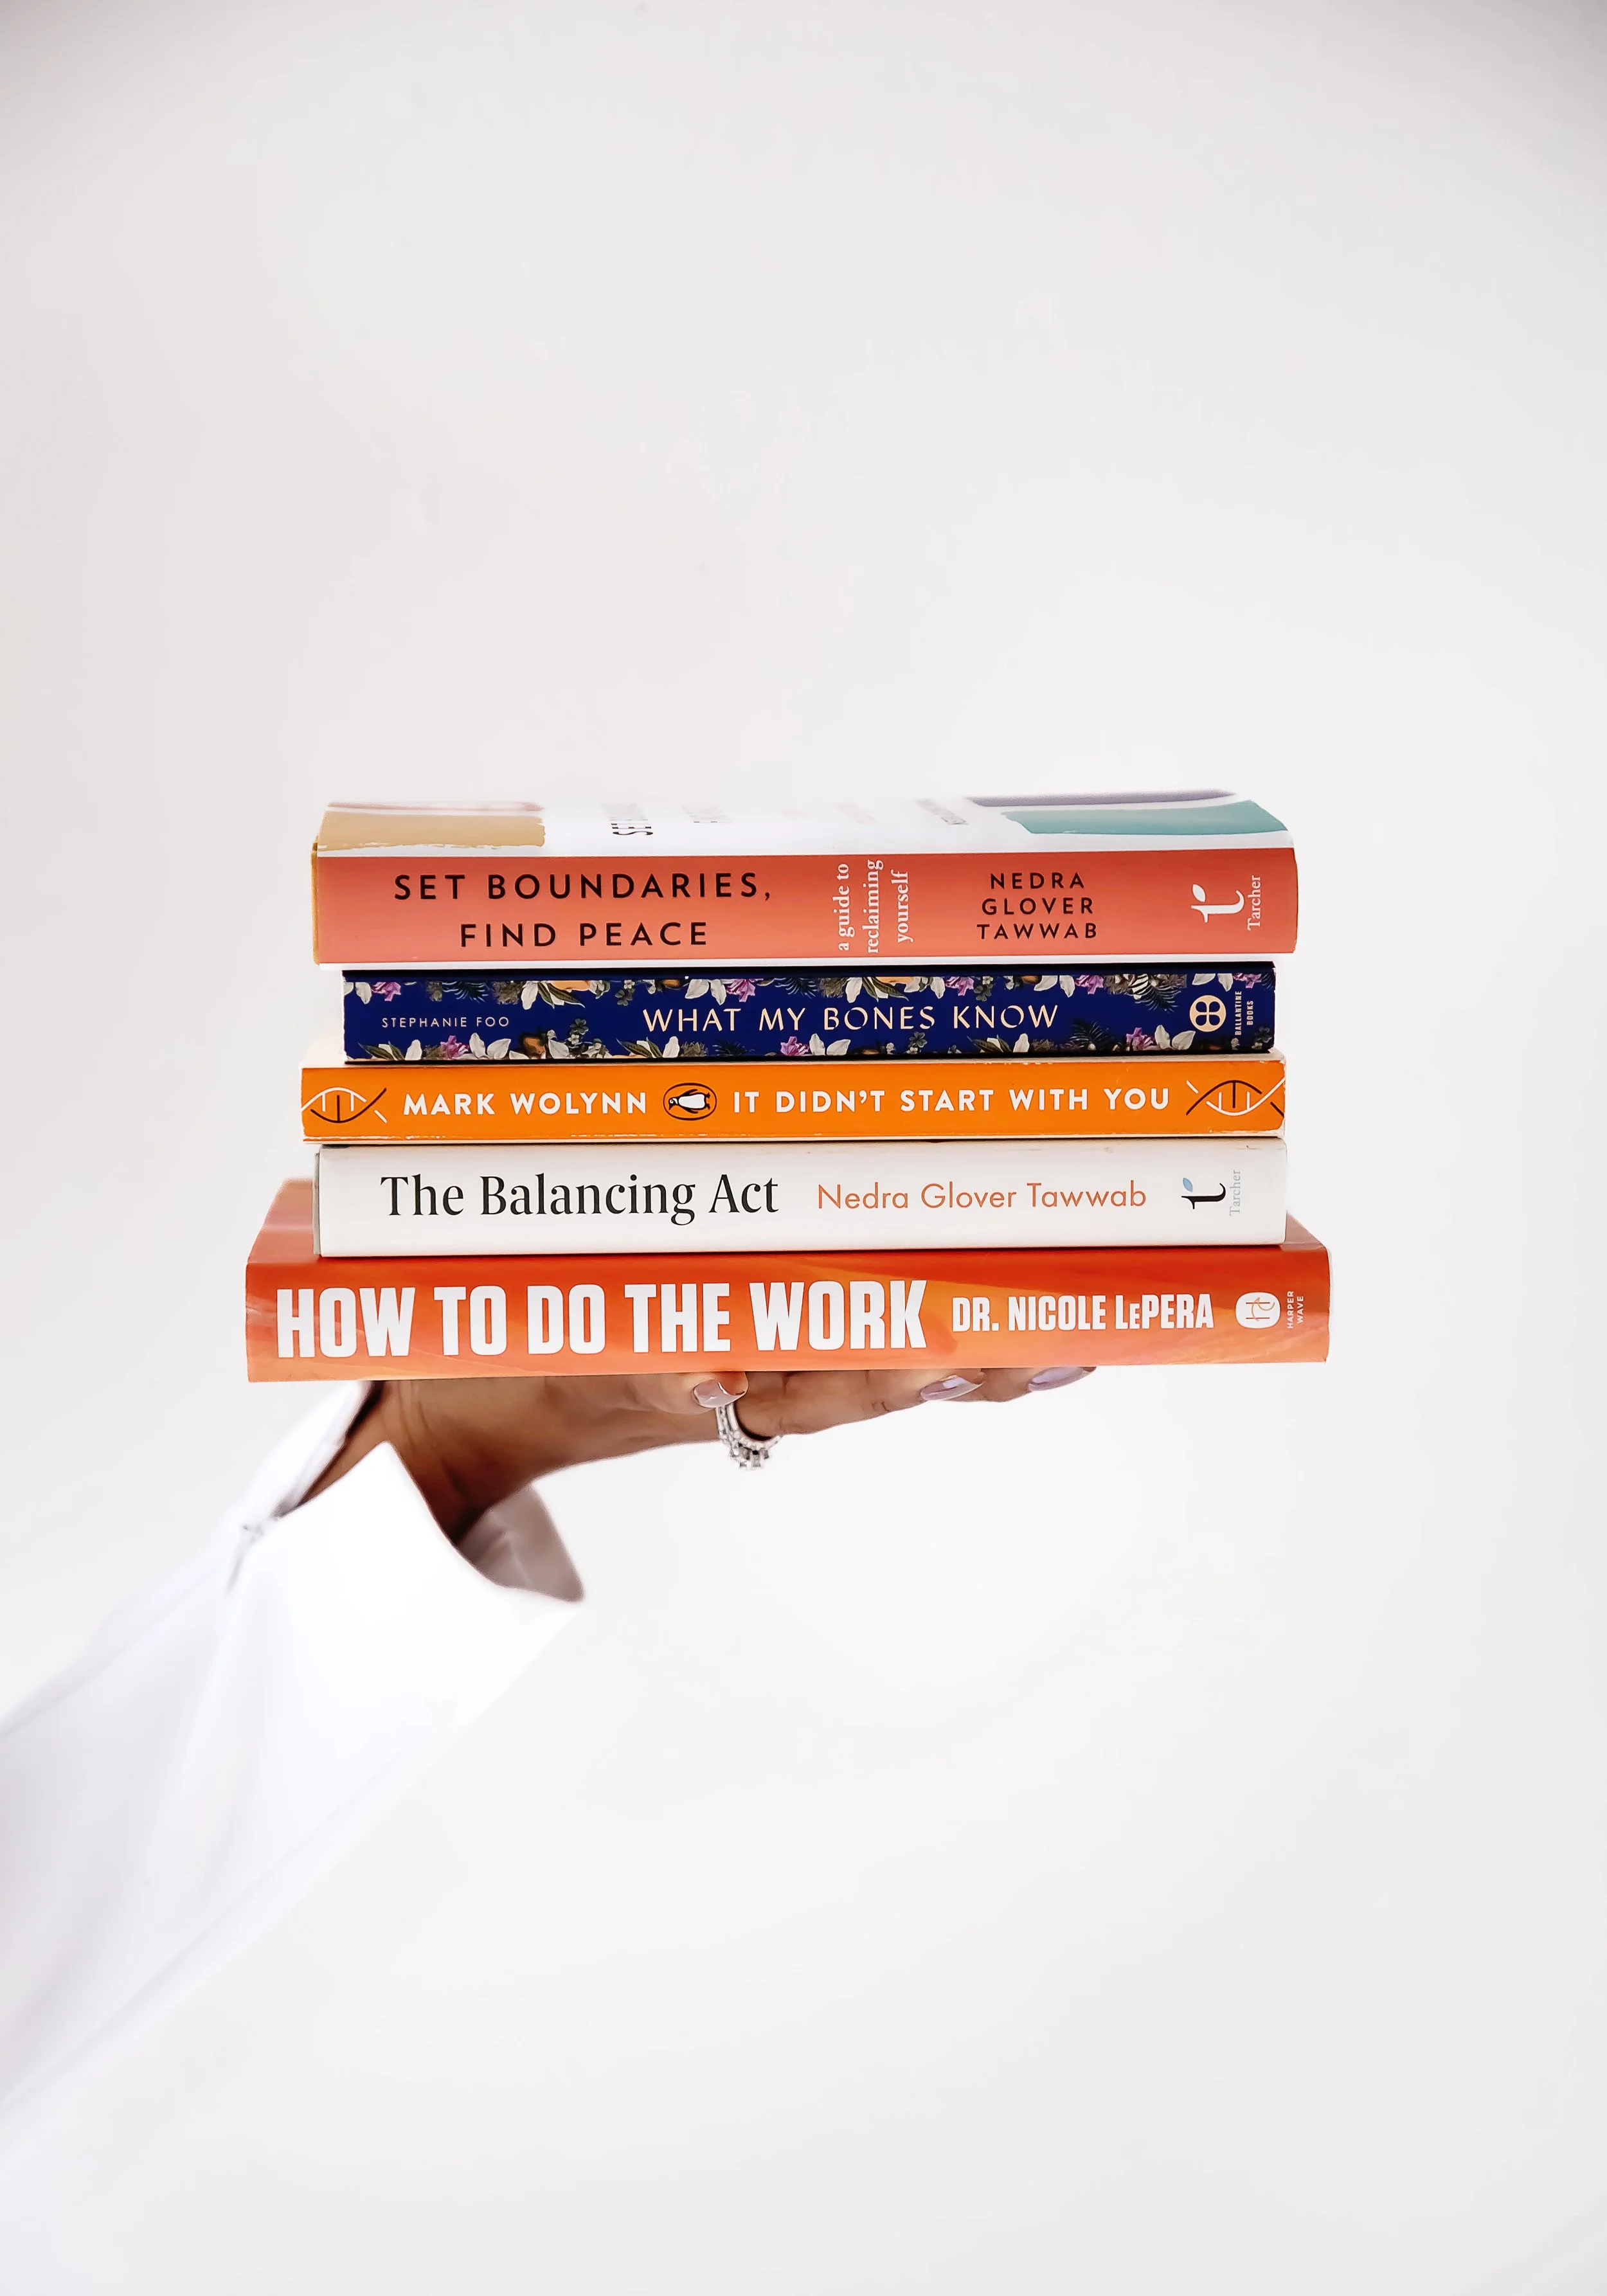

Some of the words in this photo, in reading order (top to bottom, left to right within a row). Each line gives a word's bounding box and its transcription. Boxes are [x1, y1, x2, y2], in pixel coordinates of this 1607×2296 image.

[836, 863, 849, 881] to
[990, 872, 1084, 890] NEDRA
[394, 874, 466, 901] SET
[487, 872, 771, 902] BOUNDARIES,
[832, 885, 855, 938] guide
[862, 859, 884, 953] reclaiming
[891, 869, 914, 943] yourself
[982, 897, 1093, 915] GLOVER
[1247, 874, 1261, 931] Tarcher
[460, 922, 556, 947] FIND
[580, 921, 707, 946] PEACE
[976, 922, 1097, 940] TAWWAB
[838, 942, 849, 951] a
[382, 1017, 467, 1028] STEPHANIE
[476, 1016, 509, 1028] FOO
[643, 1008, 742, 1032] WHAT
[759, 1007, 806, 1031] MY
[823, 1006, 935, 1030] BONES
[953, 1005, 1059, 1029] KNOW
[403, 1093, 495, 1115] MARK
[510, 1092, 647, 1115] WOLYNN
[733, 1091, 760, 1113] IT
[776, 1090, 885, 1113] DIDN’T
[900, 1089, 994, 1112] START
[1009, 1088, 1088, 1111] WITH
[1103, 1088, 1169, 1110] YOU
[380, 1173, 464, 1216] The
[480, 1172, 696, 1226] Balancing
[708, 1174, 780, 1214] Act
[818, 1181, 908, 1210] Nedra
[920, 1180, 1017, 1209] Glover
[1027, 1179, 1147, 1208] Tawwab
[1229, 1169, 1241, 1216] Tarcher
[276, 1287, 417, 1358] HOW
[433, 1286, 508, 1356] TO
[527, 1284, 606, 1355] DO
[624, 1282, 732, 1353] THE
[748, 1280, 928, 1351] WORK
[952, 1296, 1000, 1332] DR.
[1008, 1295, 1107, 1331] NICOLE
